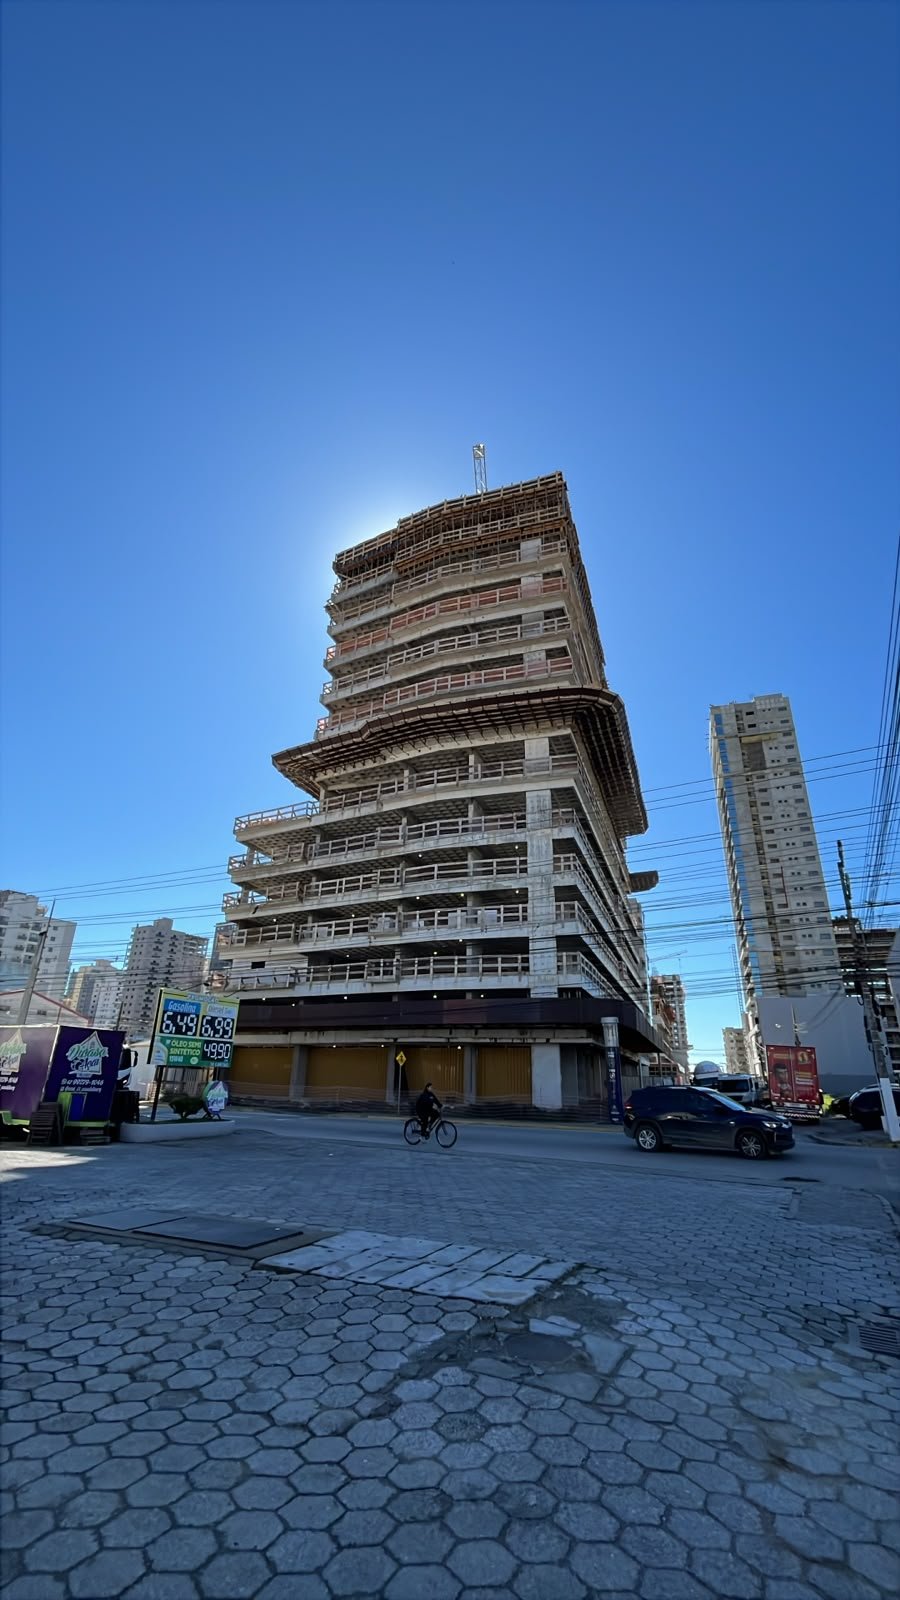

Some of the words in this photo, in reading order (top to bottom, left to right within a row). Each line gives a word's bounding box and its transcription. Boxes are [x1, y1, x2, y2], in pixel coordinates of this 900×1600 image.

[168, 1001, 197, 1012] Gasolina
[162, 1011, 197, 1036] 6,49
[201, 1016, 233, 1039] 6,99
[171, 1039, 187, 1048] ÓLEO
[203, 1042, 231, 1060] 49,90
